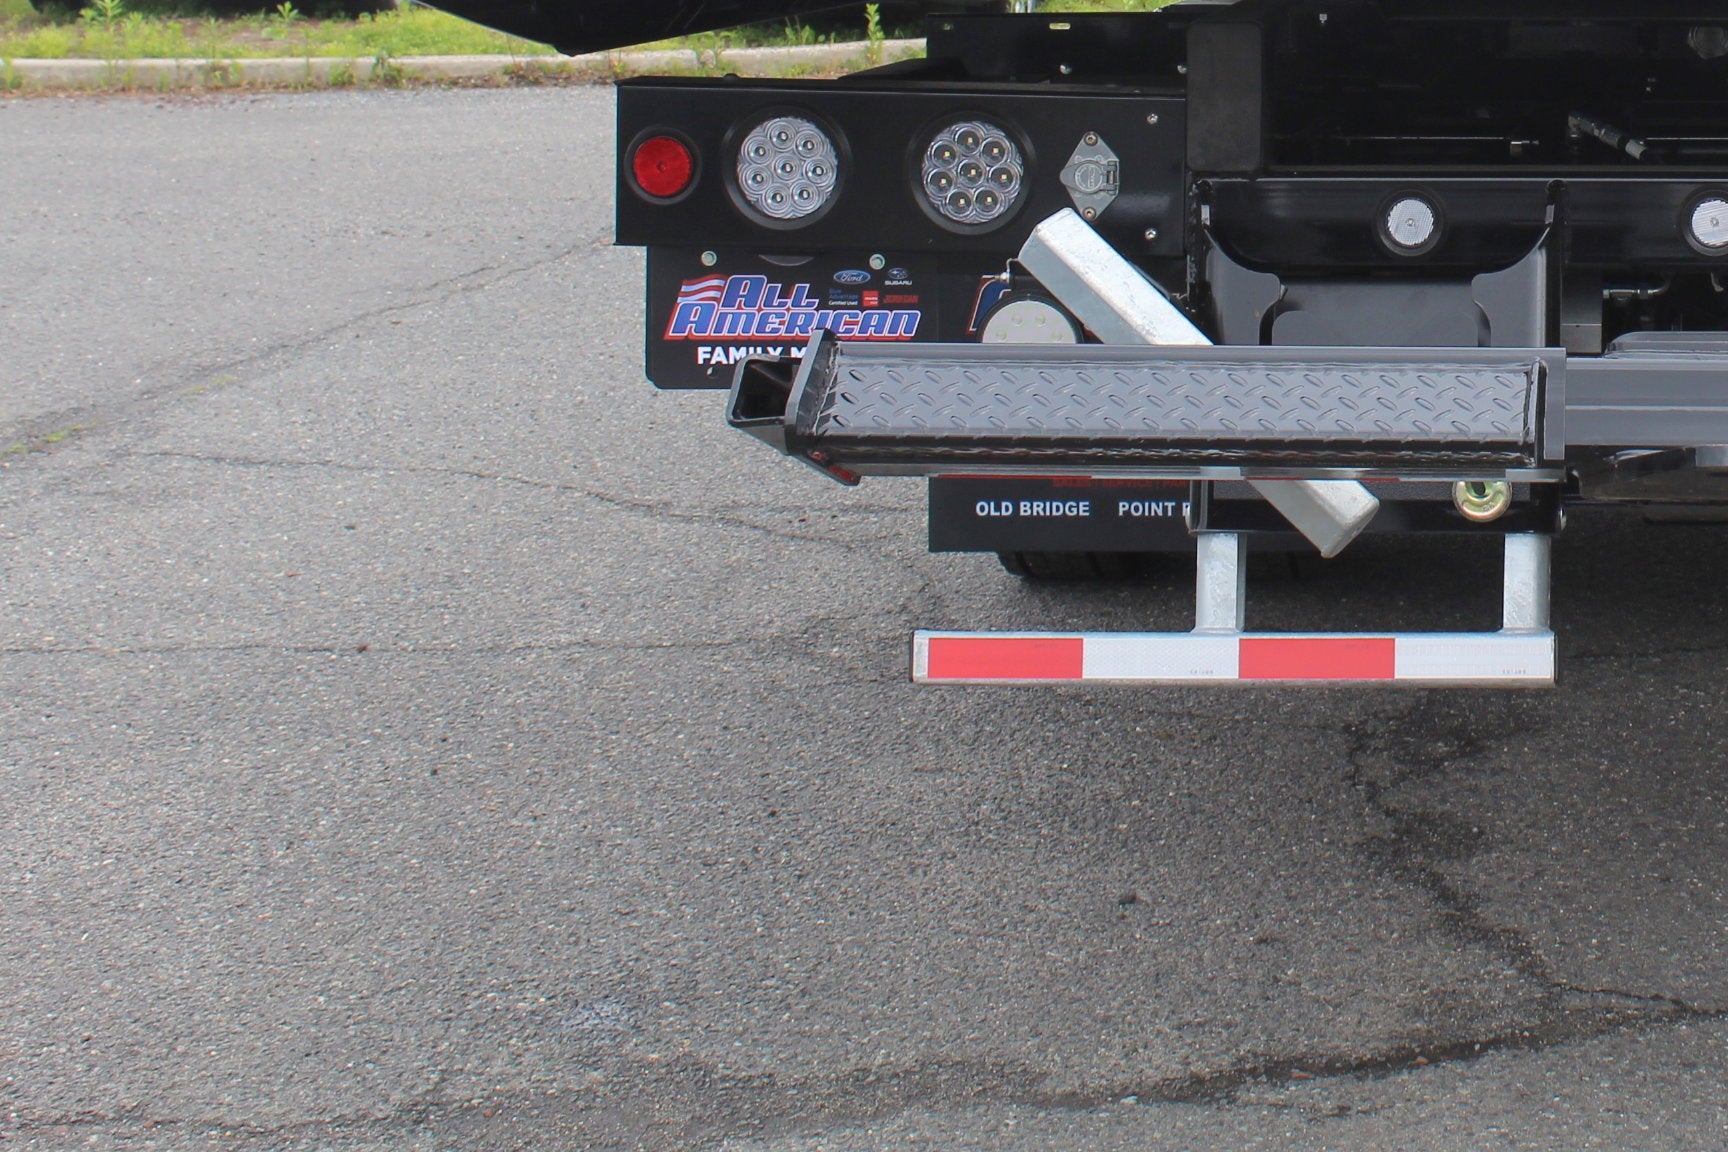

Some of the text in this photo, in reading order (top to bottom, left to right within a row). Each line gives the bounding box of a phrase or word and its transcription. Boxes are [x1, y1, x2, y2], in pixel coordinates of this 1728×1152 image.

[839, 271, 866, 283] Ford
[976, 501, 1090, 517] OLD BRIDGE
[1118, 501, 1176, 517] POINT
